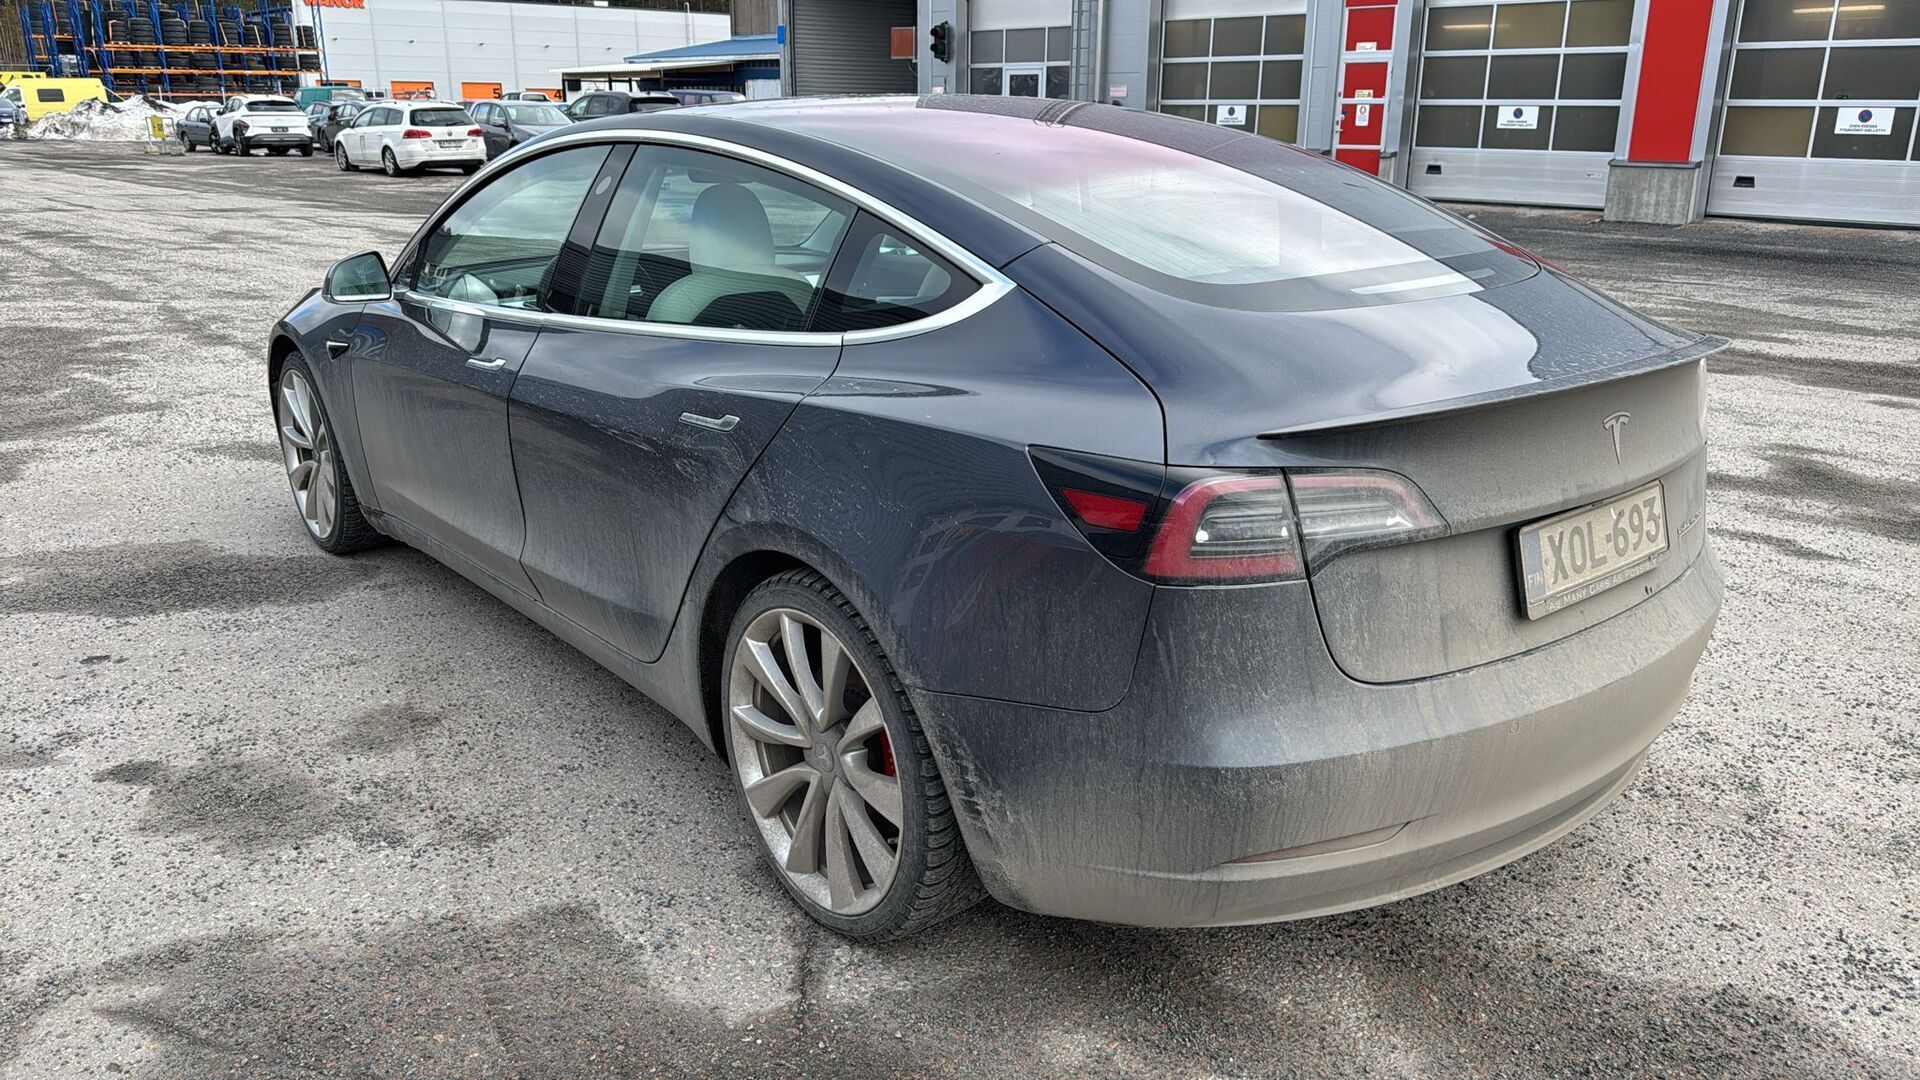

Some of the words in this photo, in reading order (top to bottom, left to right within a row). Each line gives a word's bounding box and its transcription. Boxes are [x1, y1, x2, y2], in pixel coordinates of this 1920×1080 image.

[492, 88, 501, 99] 5
[553, 89, 563, 100] 4
[1547, 495, 1661, 585] XOL-693
[1527, 571, 1544, 586] FIN
[1563, 589, 1587, 604] MANY
[1589, 581, 1610, 594] CARS
[1624, 558, 1658, 579] POSSIBLE
